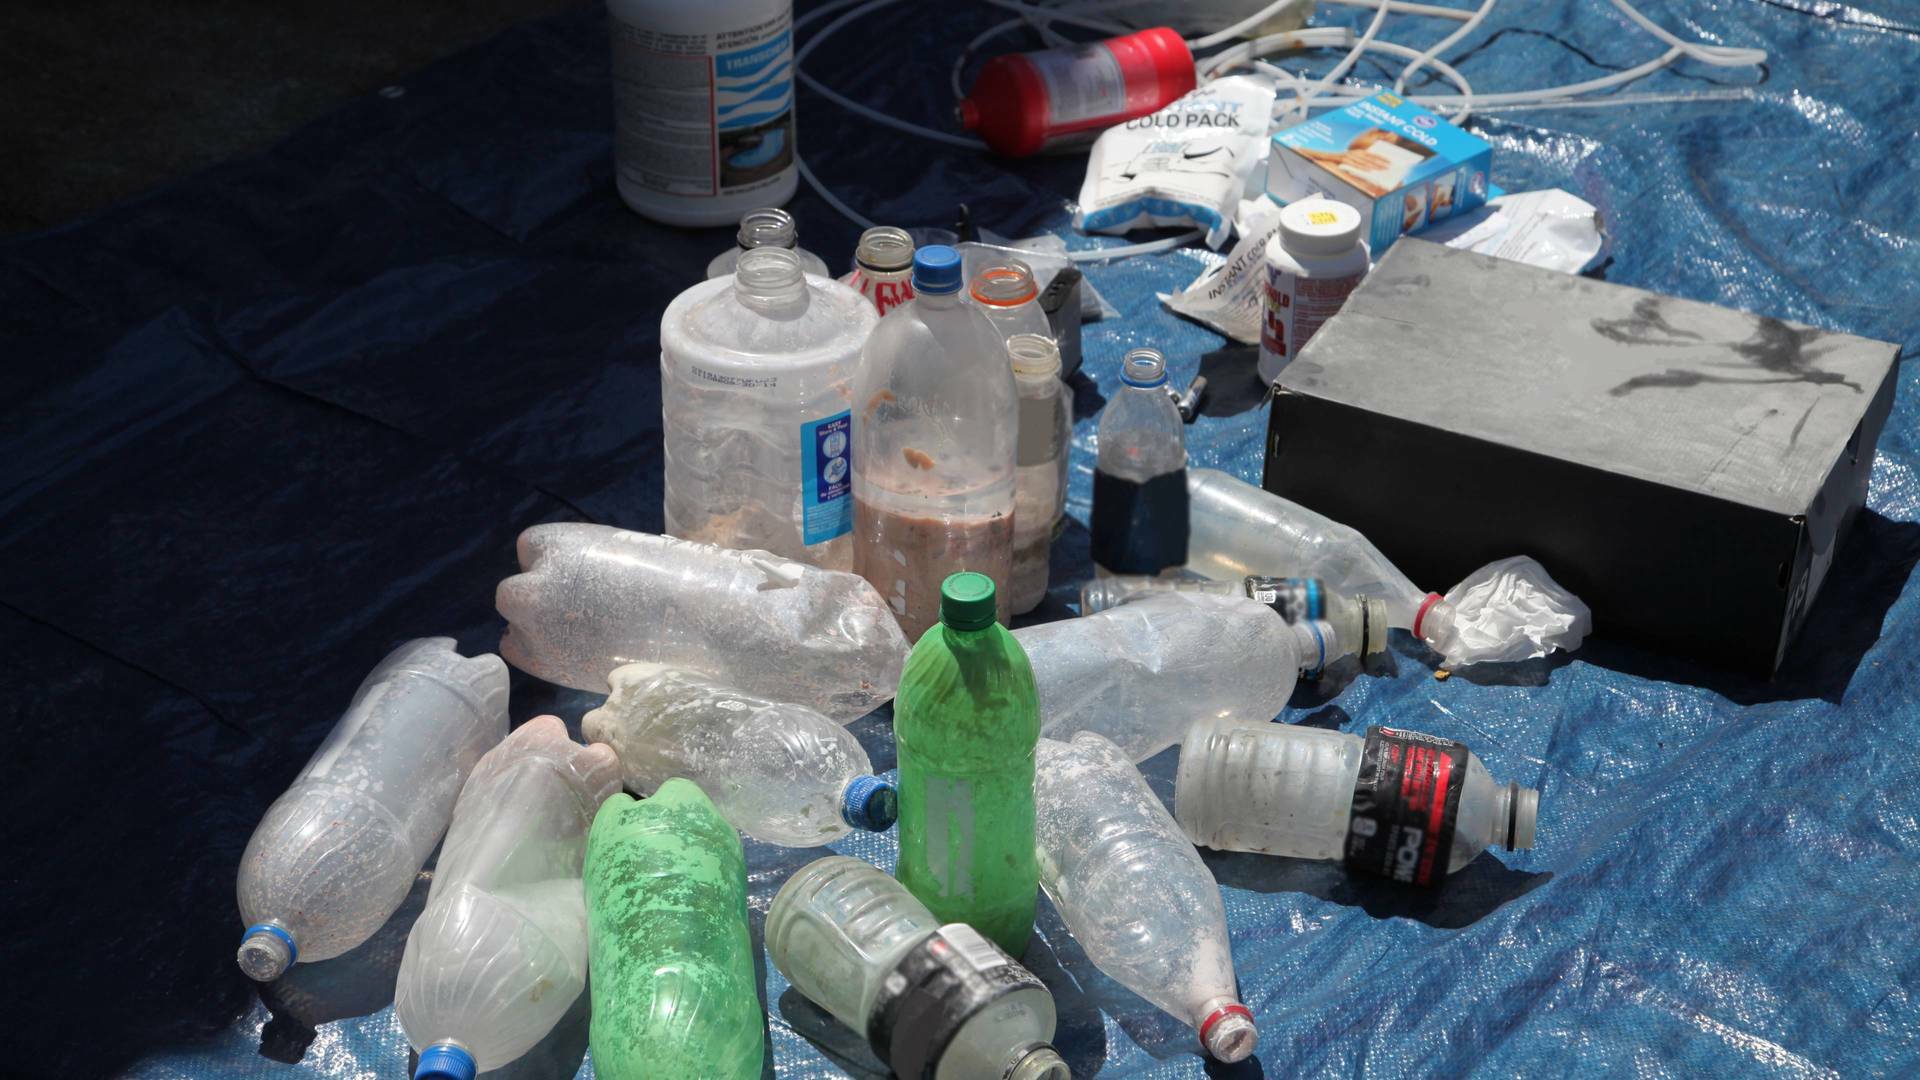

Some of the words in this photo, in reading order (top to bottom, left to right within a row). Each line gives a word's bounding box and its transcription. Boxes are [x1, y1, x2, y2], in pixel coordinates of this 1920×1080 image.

[1126, 112, 1180, 131] COLD
[1185, 112, 1240, 128] PACK
[1402, 124, 1438, 147] COLD
[1208, 255, 1248, 301] INSTANT
